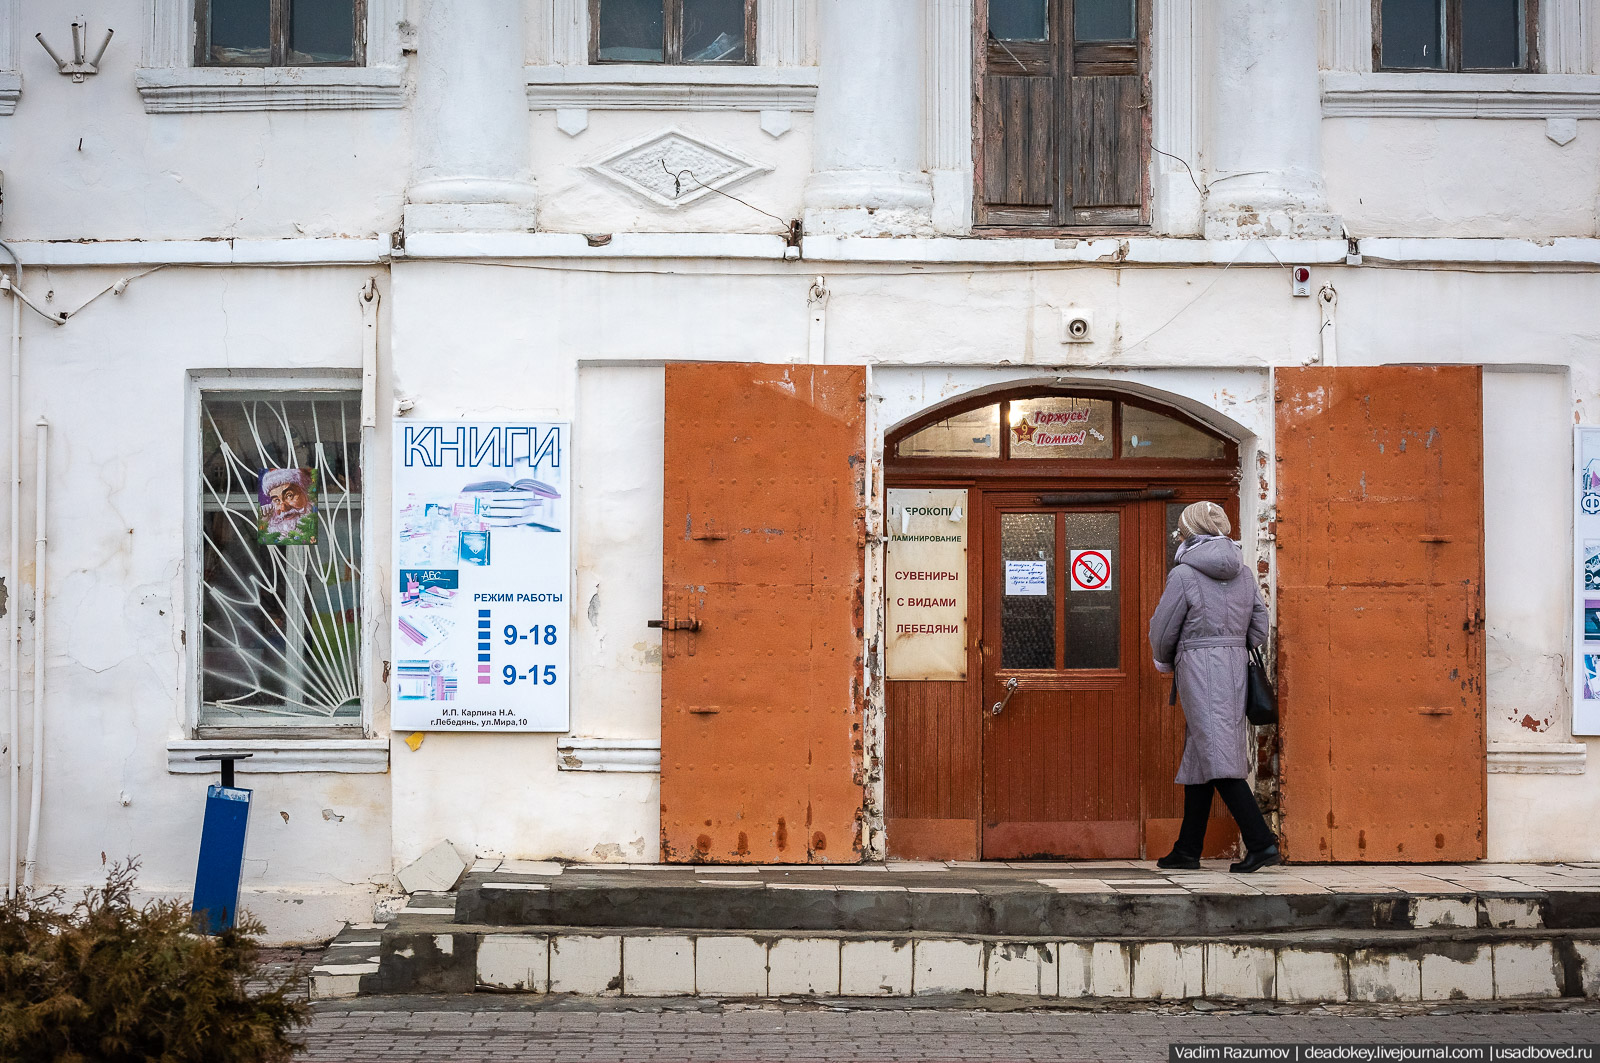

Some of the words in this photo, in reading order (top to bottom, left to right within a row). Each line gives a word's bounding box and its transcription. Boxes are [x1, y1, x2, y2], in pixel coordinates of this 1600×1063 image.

[1033, 408, 1090, 425] Горжусь!
[1021, 424, 1029, 435] 9
[1036, 431, 1085, 445] Помню!
[405, 427, 560, 467] КНИГИ
[894, 571, 959, 581] СУВЕНИРЫ
[474, 593, 514, 602] РЕЖИМ
[517, 593, 563, 602] РАБОТЫ
[896, 597, 905, 607] С
[907, 598, 957, 608] ВИДАМИ
[895, 624, 959, 634] ЛЕБЕДЯНИ
[503, 624, 558, 646] 9-18
[502, 664, 557, 686] 9-15
[498, 708, 516, 717] Н.А.
